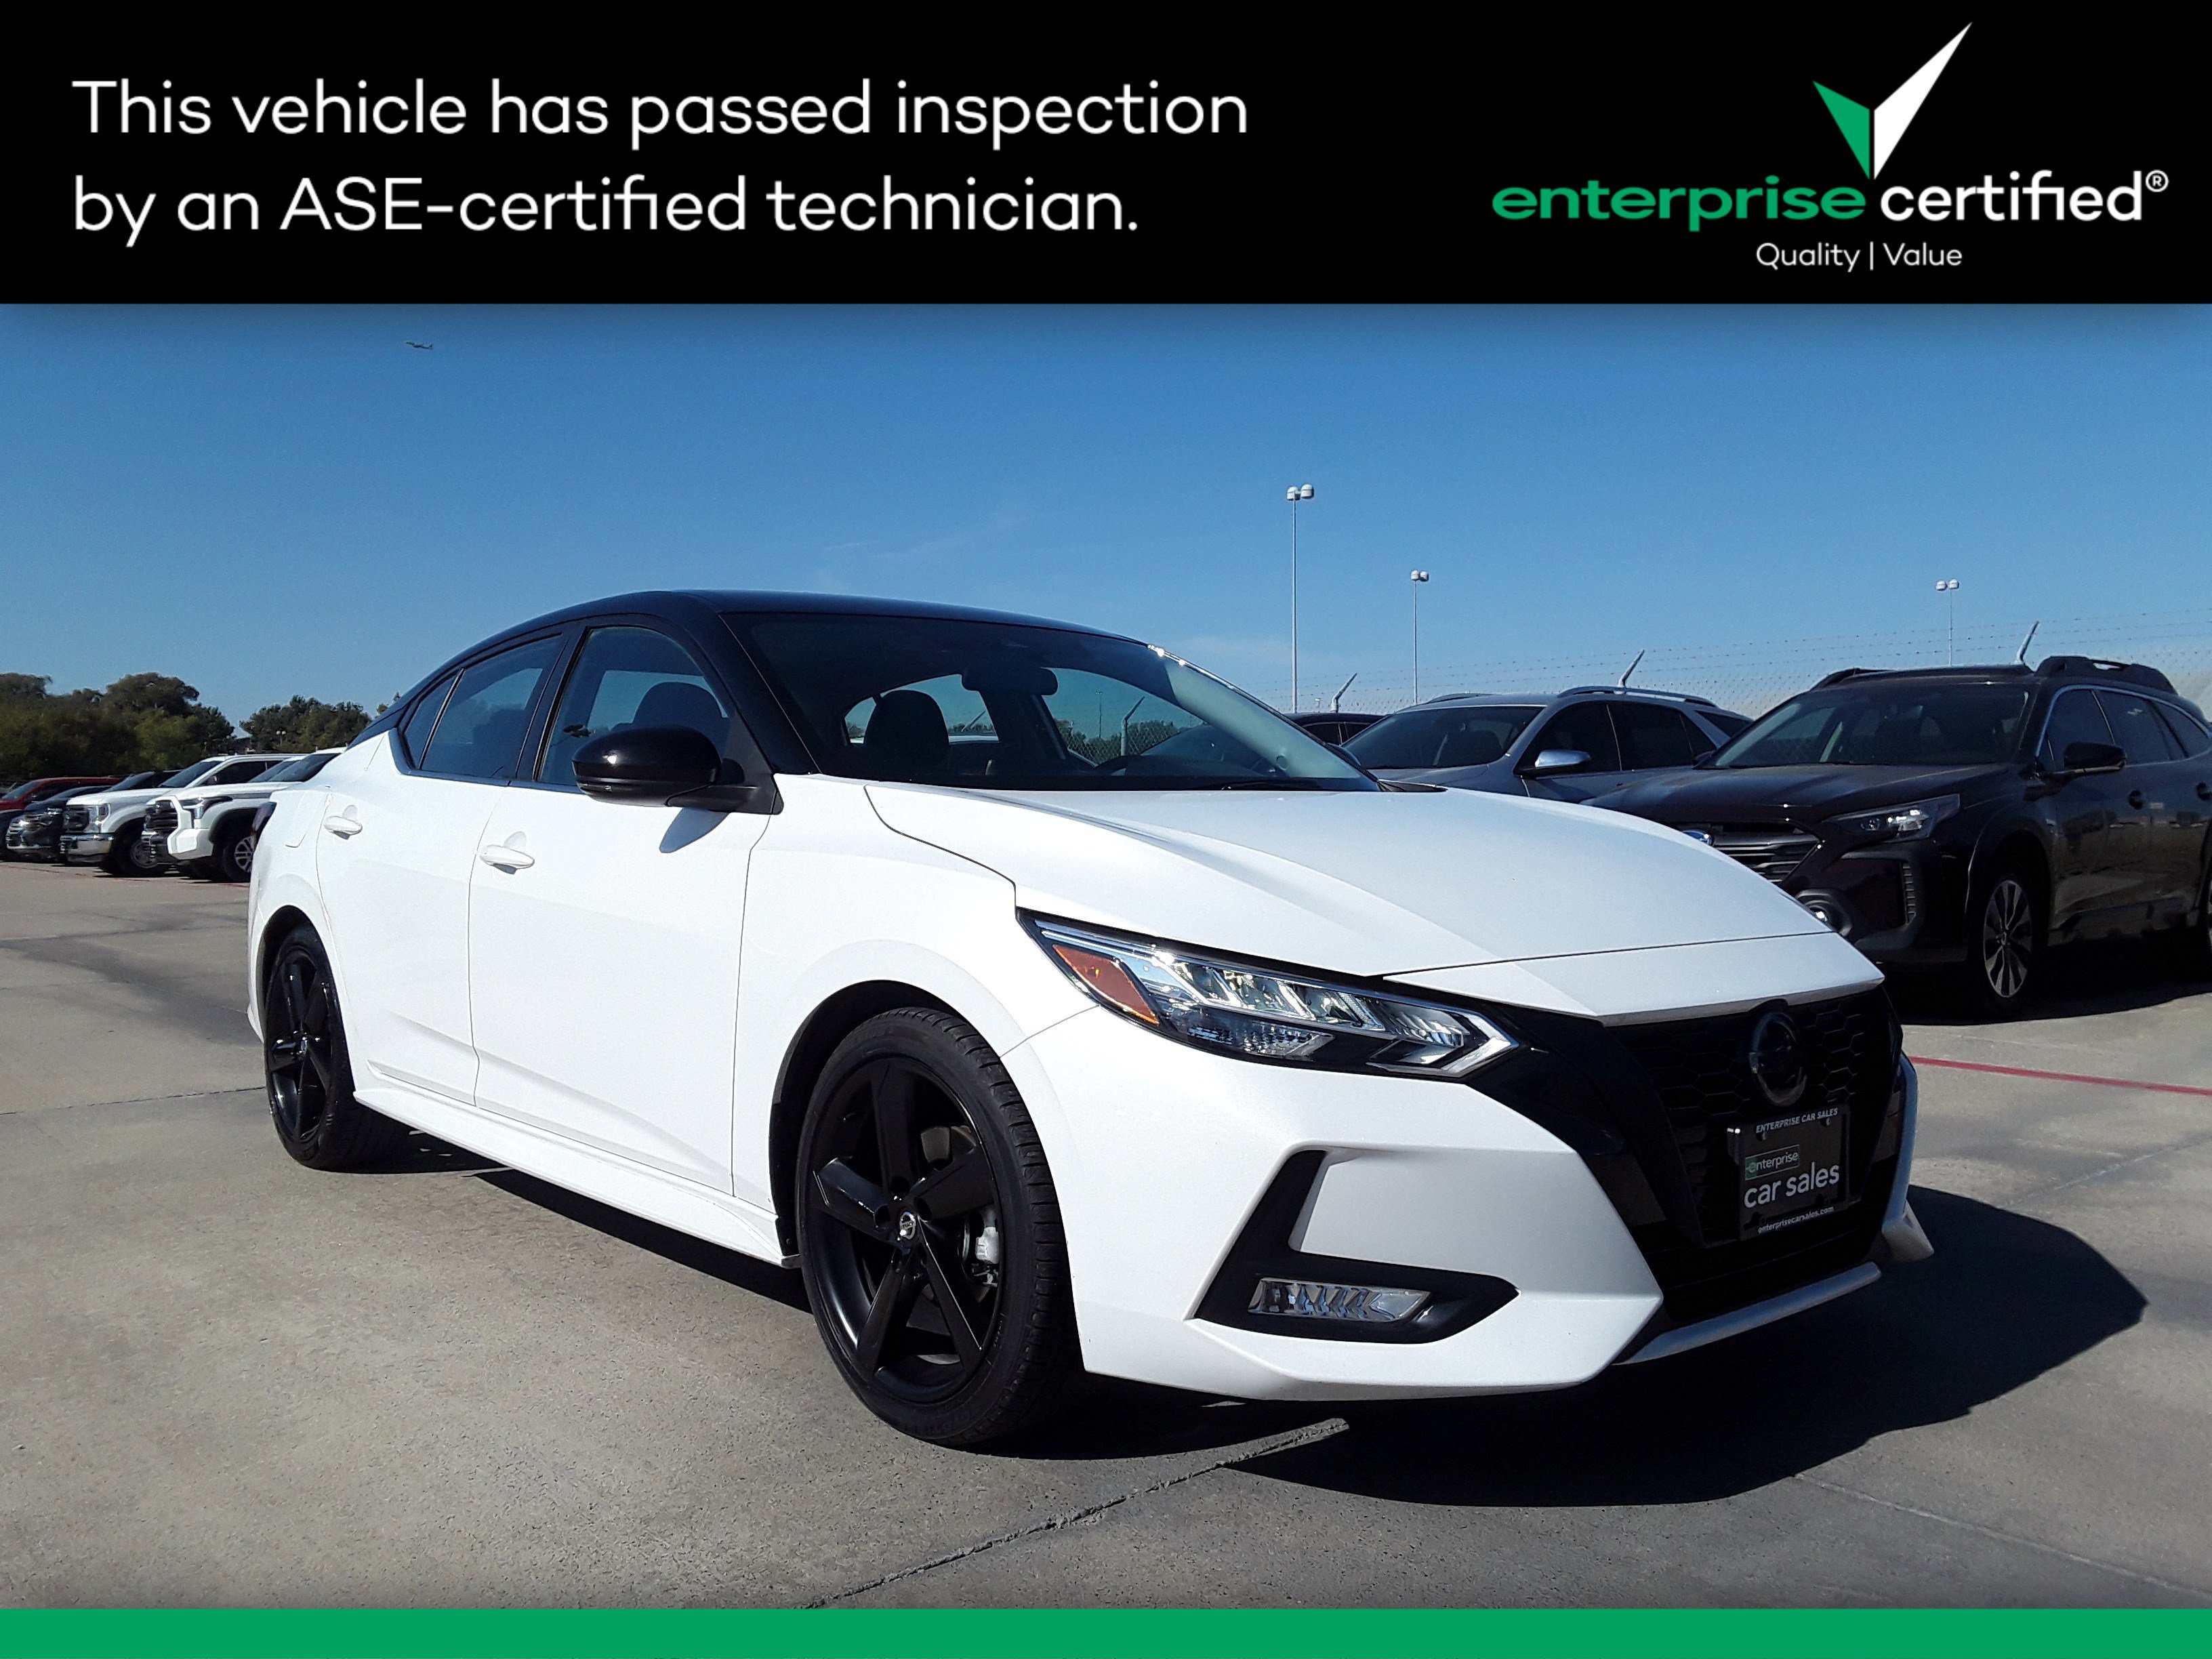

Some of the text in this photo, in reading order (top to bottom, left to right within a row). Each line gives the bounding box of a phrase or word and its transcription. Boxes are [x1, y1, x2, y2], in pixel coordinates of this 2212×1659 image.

[1756, 1107, 1839, 1134] ENTERPRISE CAR SALES
[1745, 1151, 1799, 1174] enterprise
[1744, 1162, 1841, 1208] car sales
[1757, 1206, 1835, 1234] enterprisecarsales.com
